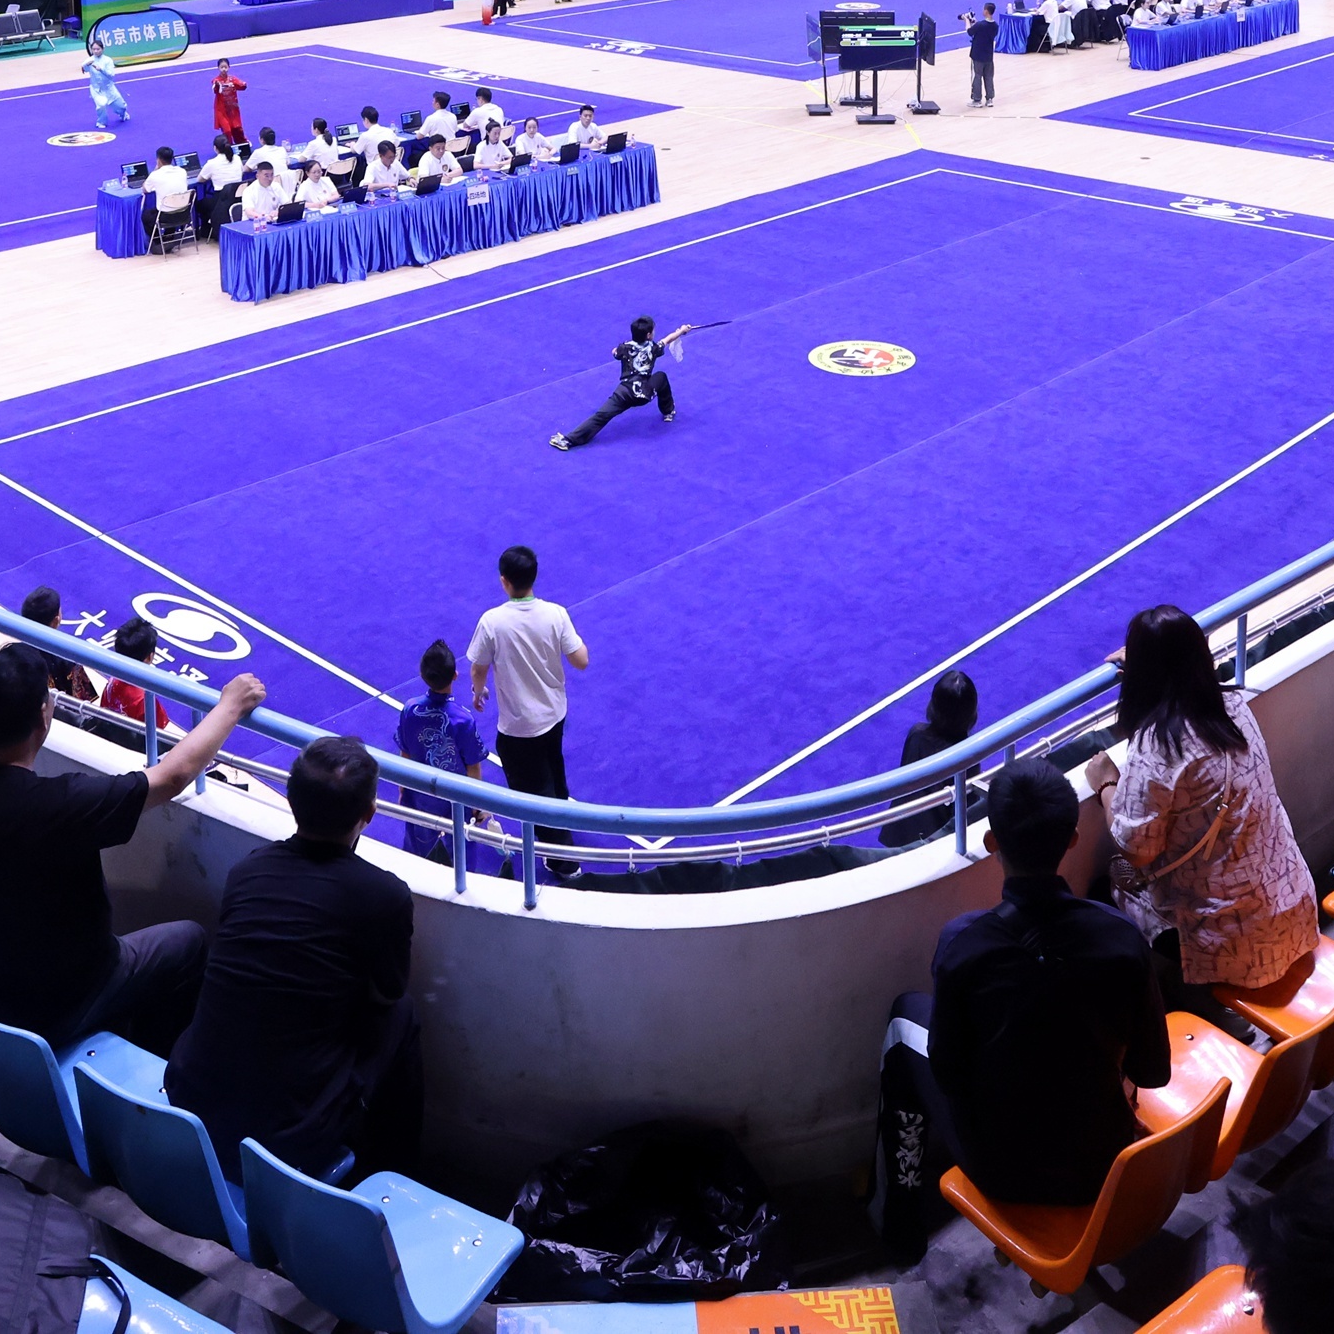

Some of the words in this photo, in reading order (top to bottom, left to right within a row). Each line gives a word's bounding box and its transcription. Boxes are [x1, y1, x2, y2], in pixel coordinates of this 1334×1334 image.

[98, 20, 186, 47] 北京市体育局
